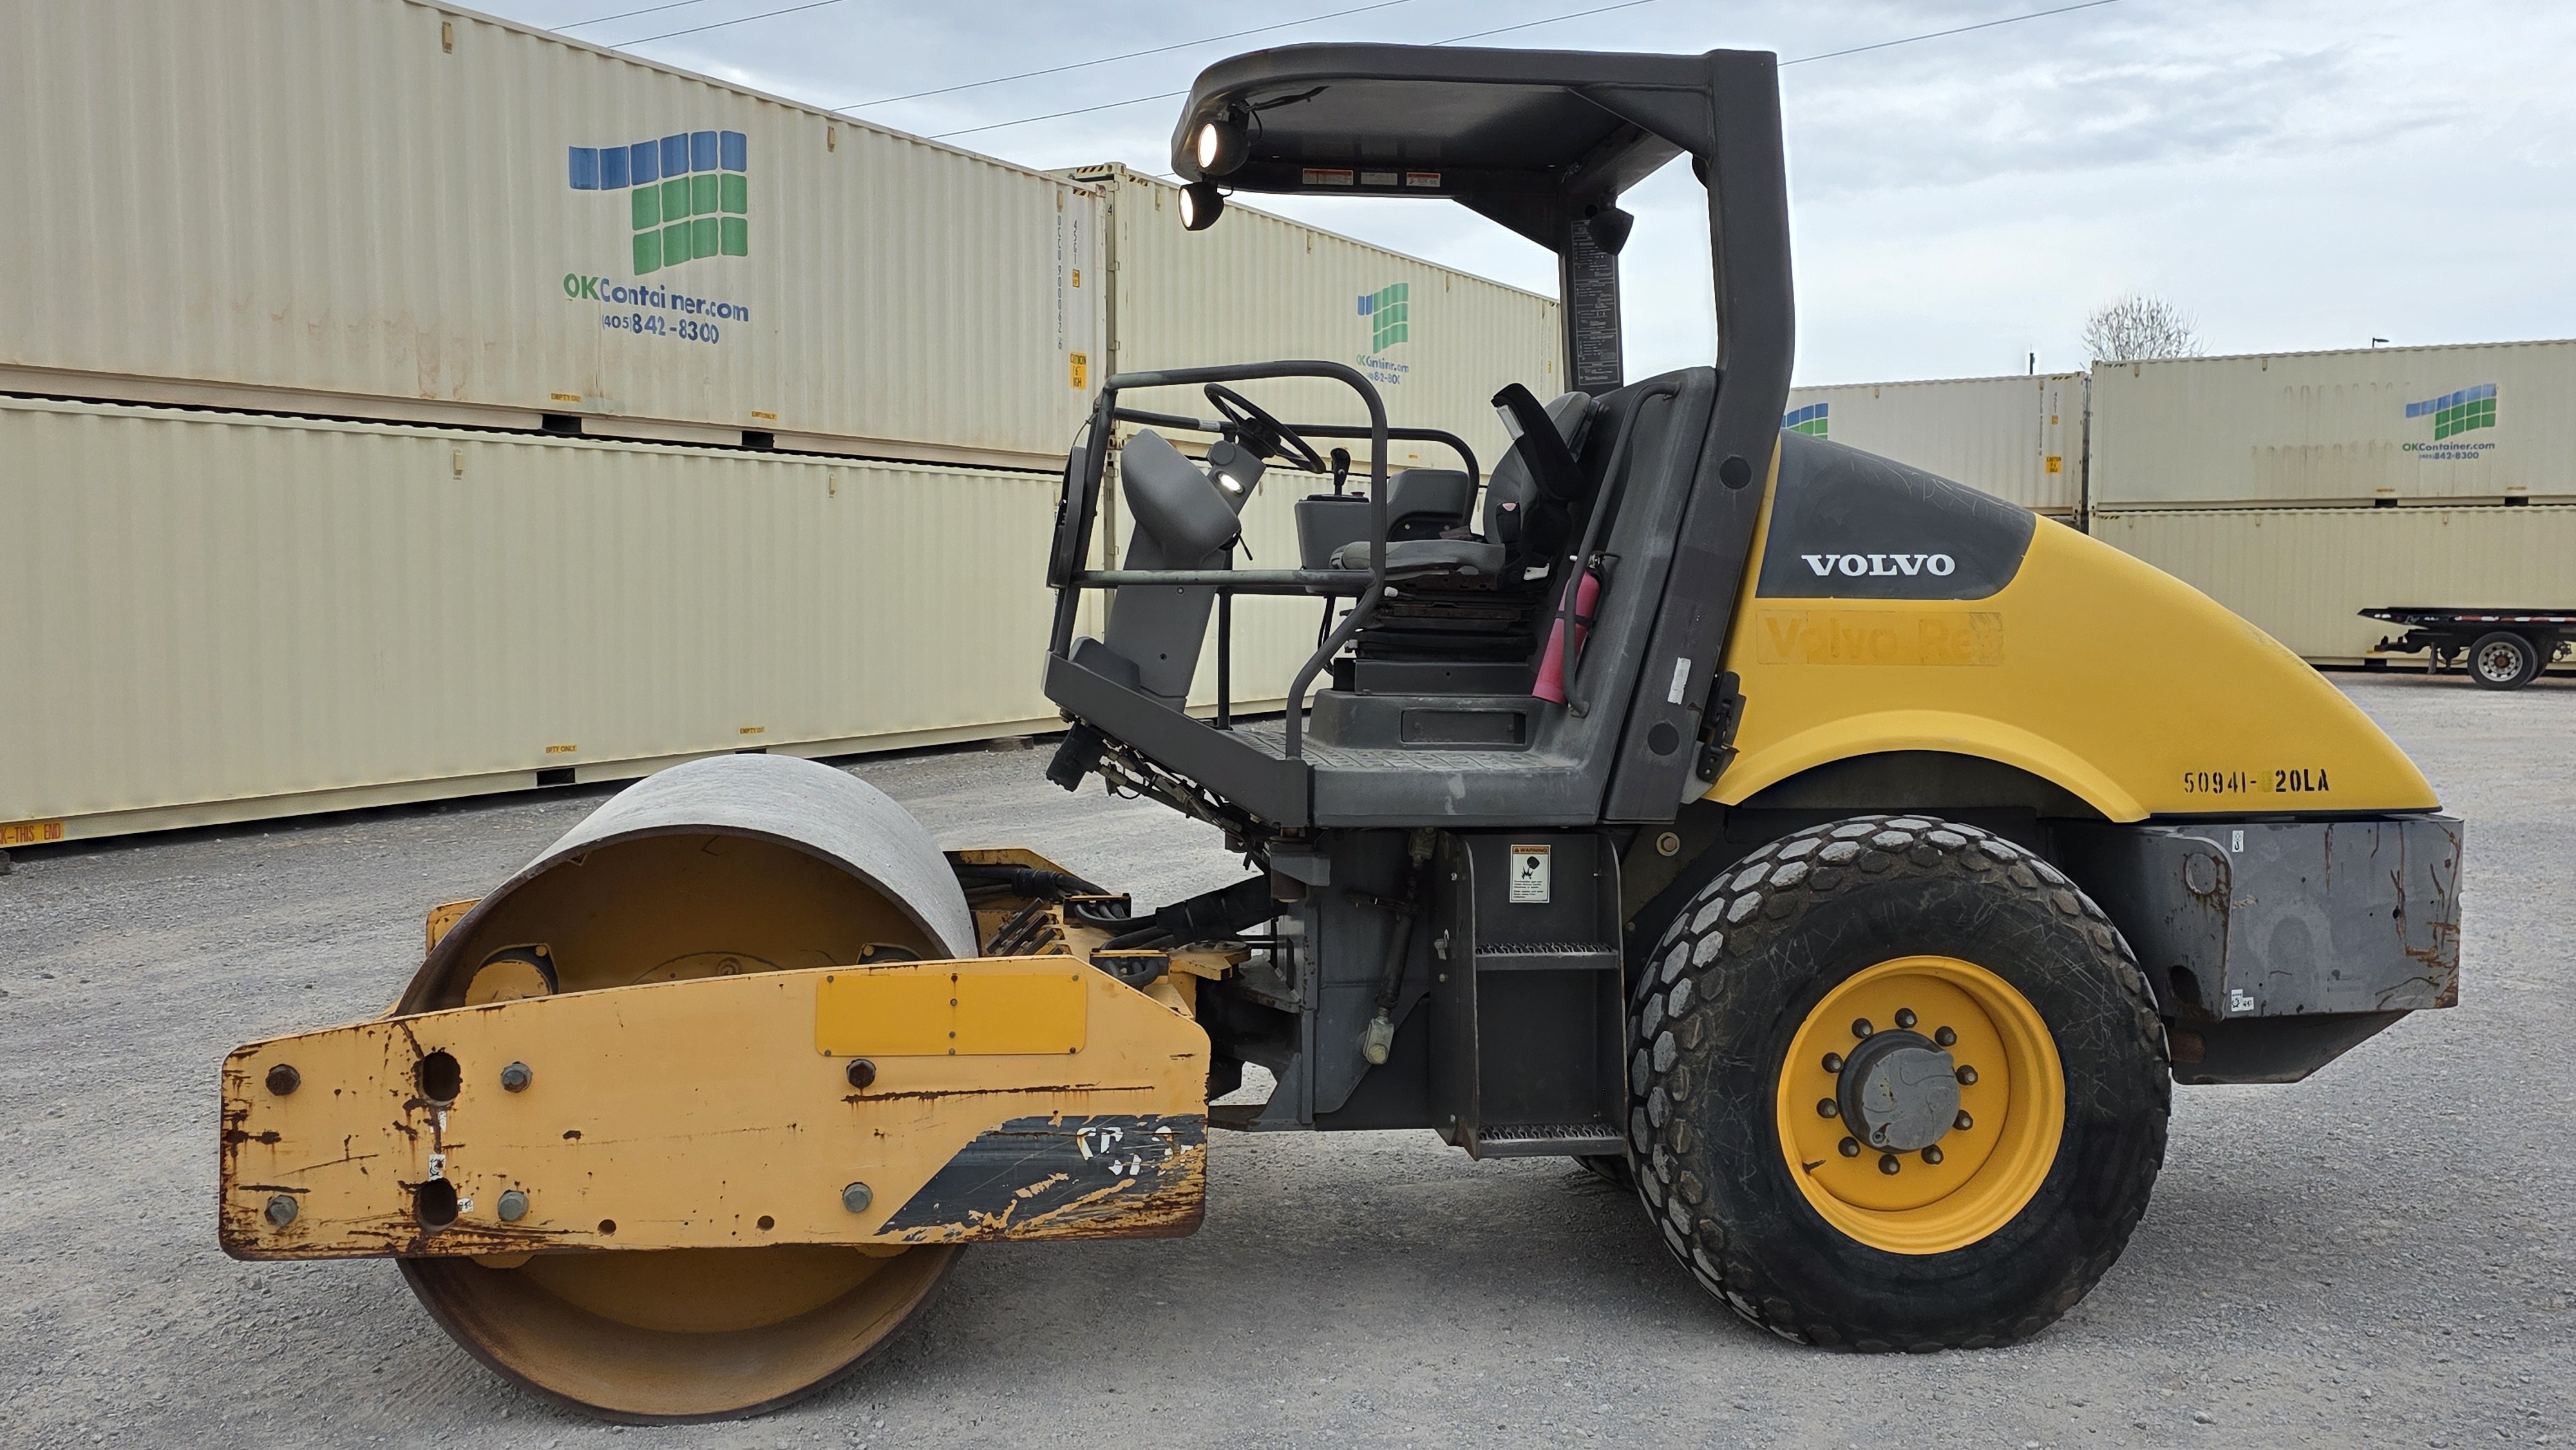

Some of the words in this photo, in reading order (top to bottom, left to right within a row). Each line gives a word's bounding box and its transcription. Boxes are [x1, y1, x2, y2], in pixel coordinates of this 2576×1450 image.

[563, 272, 750, 323] OKContainer.com
[2402, 442, 2496, 451] OKContainer.com
[1801, 554, 1956, 576] VOLVO
[43, 822, 61, 840] END
